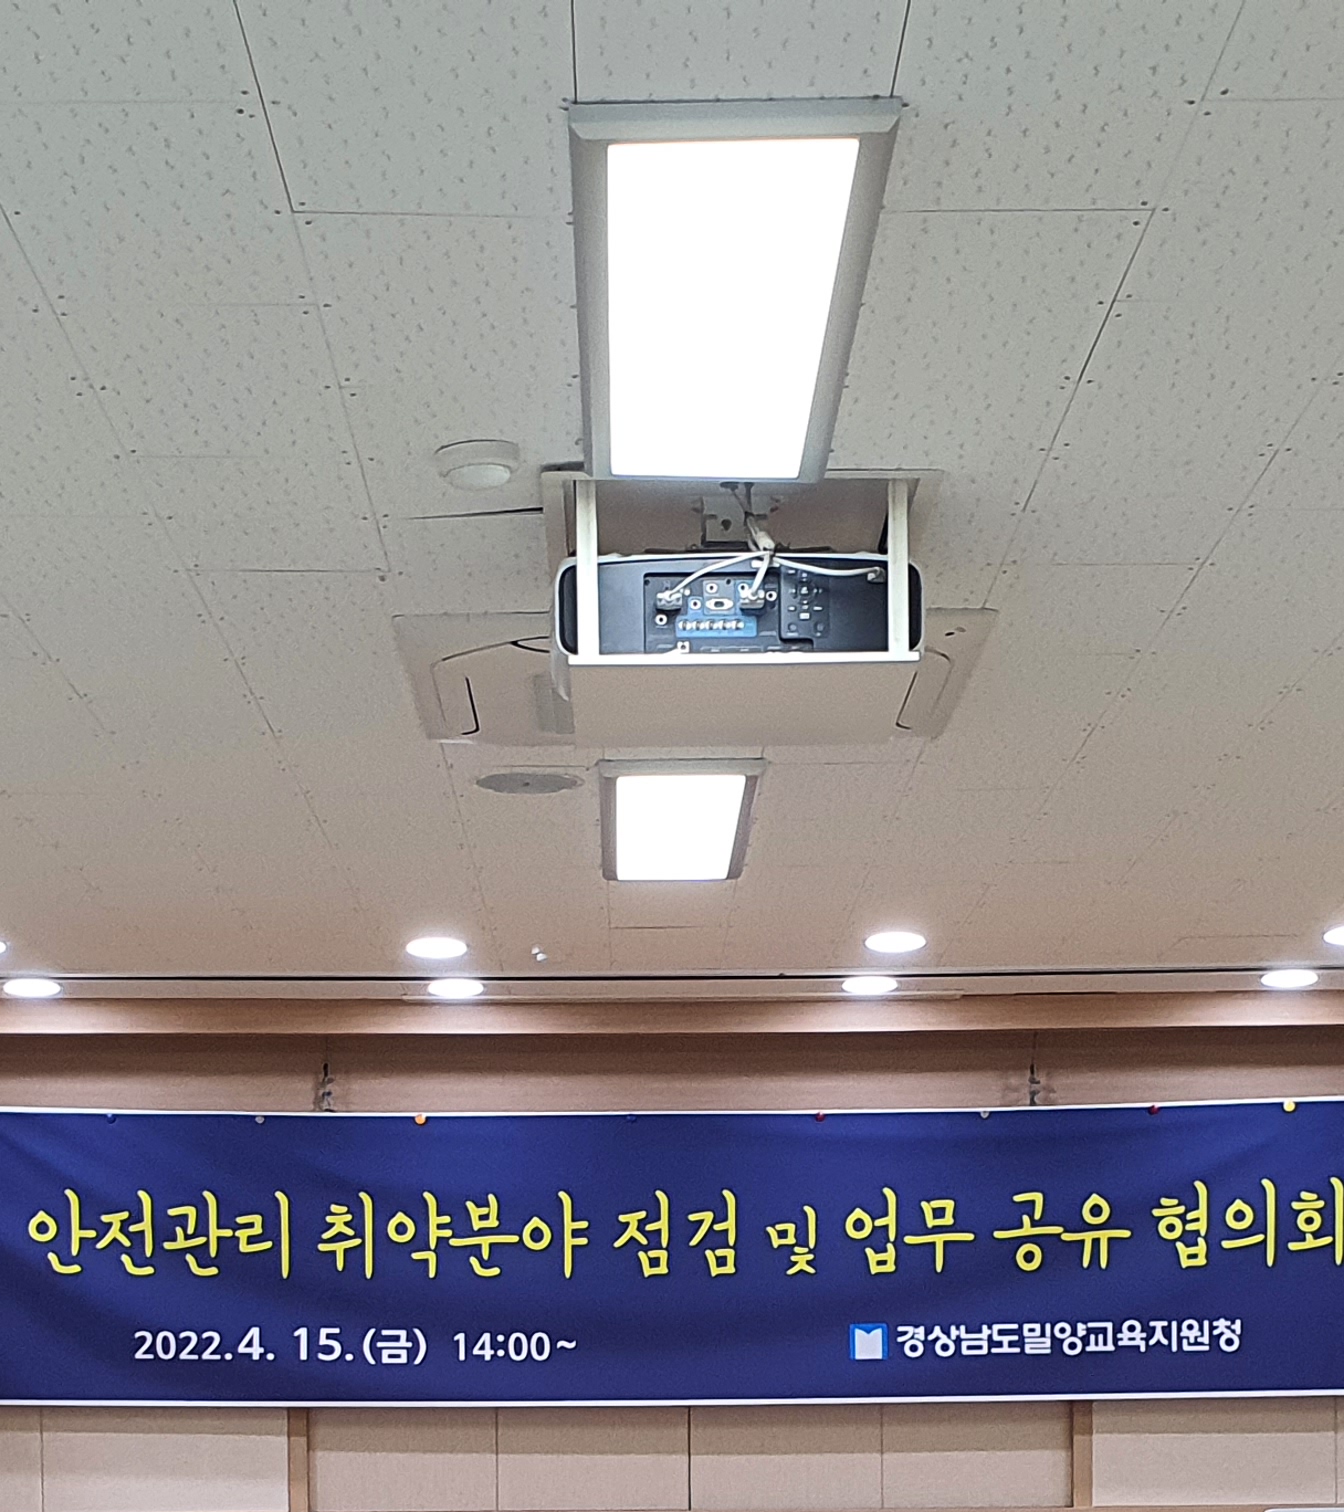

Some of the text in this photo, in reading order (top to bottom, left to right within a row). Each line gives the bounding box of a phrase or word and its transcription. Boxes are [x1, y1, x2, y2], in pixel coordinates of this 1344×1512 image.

[27, 1176, 1344, 1279] 안전관리 취약분야 점검 및 업무 공유 협의회
[133, 1325, 276, 1362] 2022.4.
[452, 1330, 578, 1363] 14:00~
[895, 1317, 1243, 1359] 경상남도밀양교육지원청
